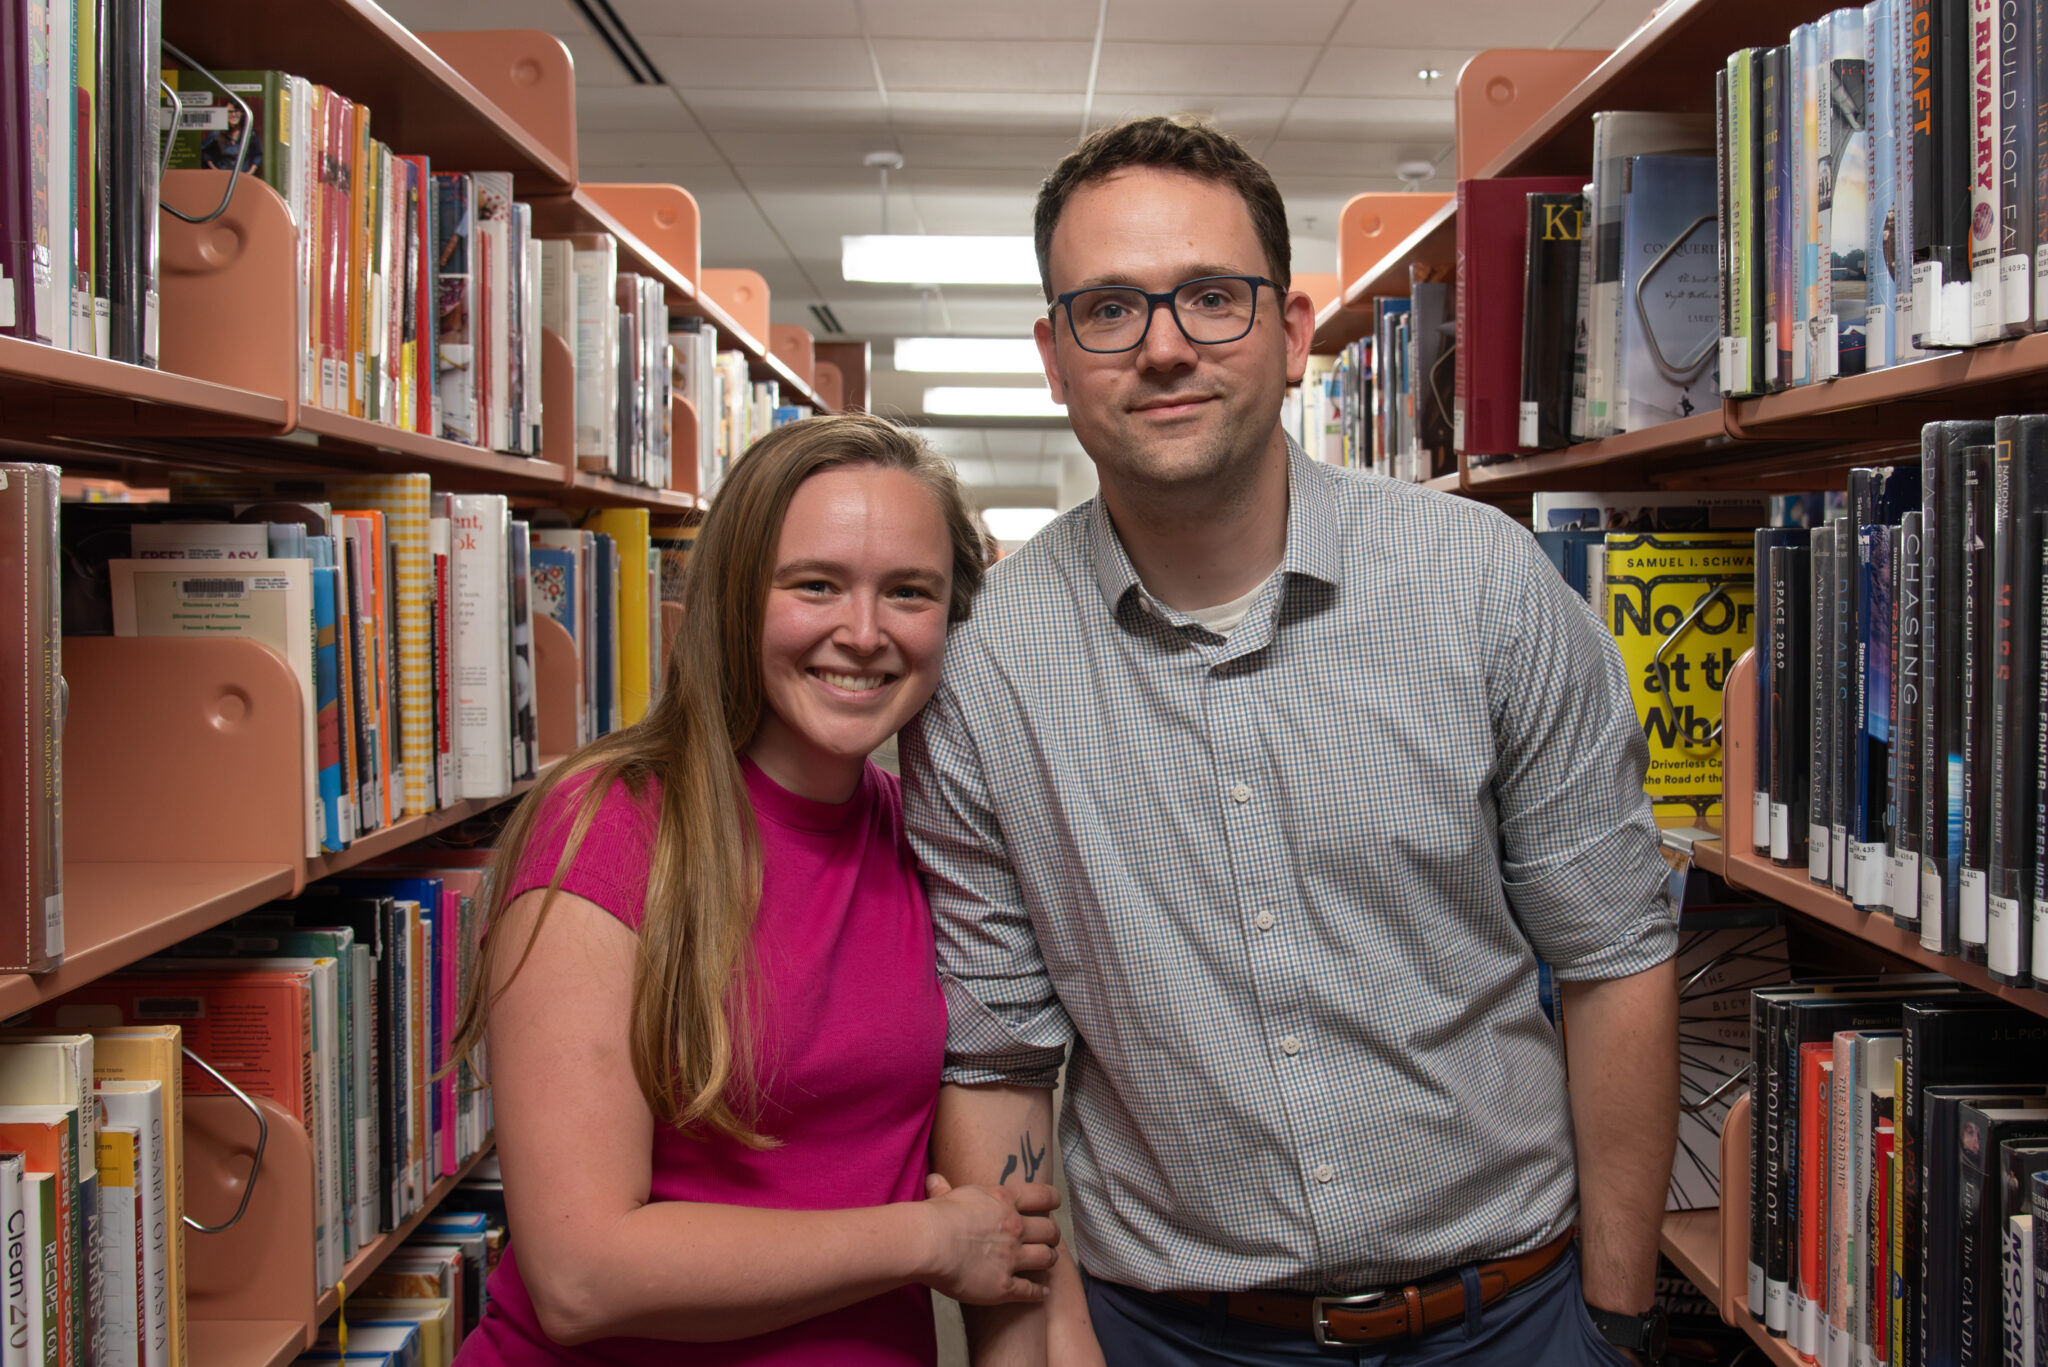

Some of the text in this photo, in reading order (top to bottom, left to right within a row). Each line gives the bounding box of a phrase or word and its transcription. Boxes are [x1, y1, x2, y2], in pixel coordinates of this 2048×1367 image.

[2001, 0, 2017, 111] COULD
[1867, 23, 1876, 201] HIDDEN FIGURES
[1905, 90, 1913, 183] FIGURES
[1975, 17, 1993, 191] RIVALRY
[1894, 99, 1902, 192] FIGURES
[2002, 124, 2017, 188] NOT
[2001, 465, 2009, 519] NATIONAL
[1627, 556, 1755, 568] SAMUEL I. SCHWA
[1922, 448, 1936, 687] SPACE SHUTTLE
[1965, 562, 1973, 641] SPACE
[1614, 593, 1685, 637] No
[1775, 580, 1785, 670] SPACE 2069
[1837, 578, 1848, 700] DREAMS
[1903, 533, 1921, 705] CHASING
[2040, 573, 2048, 704] CONSEQUENTIAL
[1644, 653, 1690, 694] at
[1813, 574, 1824, 819] AMBASSADORS FROM EARTH
[1857, 641, 1866, 729] Space Exploration
[44, 635, 53, 799] A HISTORICAL COMPANION
[1926, 704, 1935, 730] THE
[1926, 735, 1934, 772] FIRST
[2038, 711, 2048, 790] FRONTIER
[1651, 758, 1706, 770] Driverless
[1664, 774, 1692, 785] Road
[1694, 773, 1706, 784] of
[1887, 725, 1897, 827] mars
[1925, 799, 1934, 842] YEARS
[2036, 803, 2046, 855] PETER
[1855, 1095, 1864, 1128] JOHN
[1904, 1028, 1914, 1117] PICTURING
[60, 1132, 69, 1209] SUPER
[1766, 1064, 1778, 1226] APOLLO PILOT
[1838, 1074, 1847, 1189] THE ASTRONAUT
[70, 1182, 79, 1222] WILD
[1855, 1146, 1864, 1200] KENNEDY
[1903, 1127, 1916, 1229] APOLLO
[1962, 1181, 1975, 1225] Light
[7, 1209, 26, 1299] Clean
[44, 1240, 59, 1318] RECIPE
[61, 1211, 71, 1292] FOODS
[71, 1228, 80, 1293] WISDOM
[87, 1214, 100, 1320] ACORNS
[1963, 1234, 1974, 1269] This
[152, 1267, 166, 1352] PASTA
